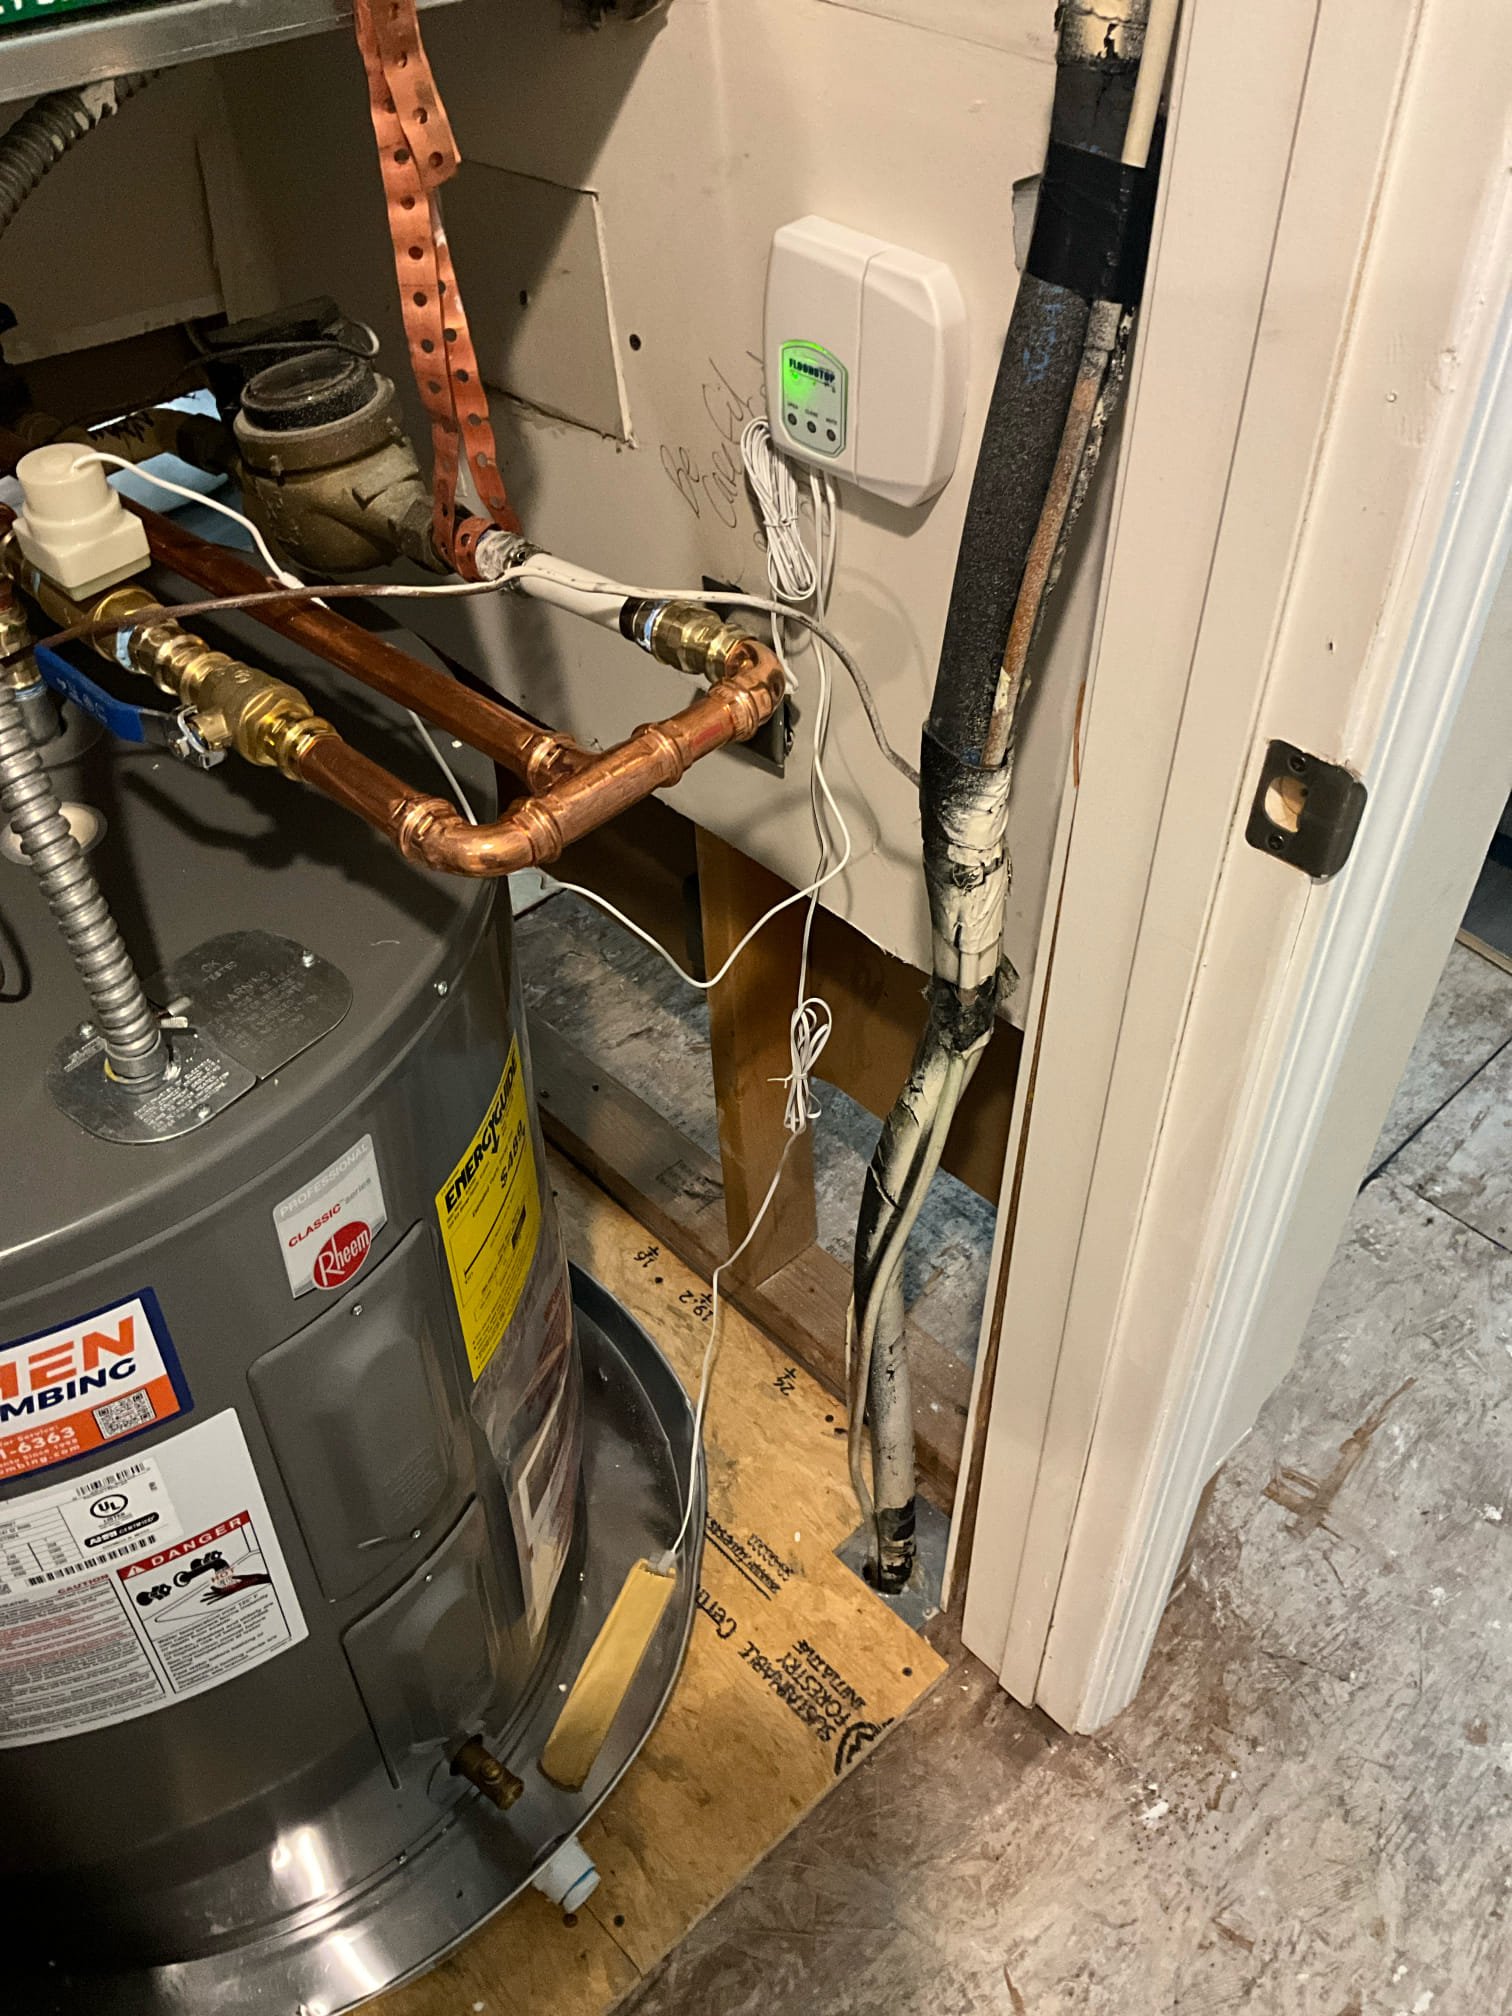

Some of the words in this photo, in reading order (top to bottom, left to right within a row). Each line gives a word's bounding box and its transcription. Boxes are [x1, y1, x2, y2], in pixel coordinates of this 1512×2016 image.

[279, 1143, 368, 1217] PROFESSIONAL
[288, 1203, 341, 1248] CLASSIC
[318, 1229, 370, 1286] Rheem
[97, 1501, 121, 1512] UL
[151, 1517, 243, 1566] DANGER
[57, 1574, 109, 1594] CAUTION
[210, 1567, 235, 1583] HOT
[738, 1641, 837, 1742] SUSTAINABLE
[776, 1652, 850, 1727] FORESTRY
[792, 1640, 866, 1708] INITIATIVE
